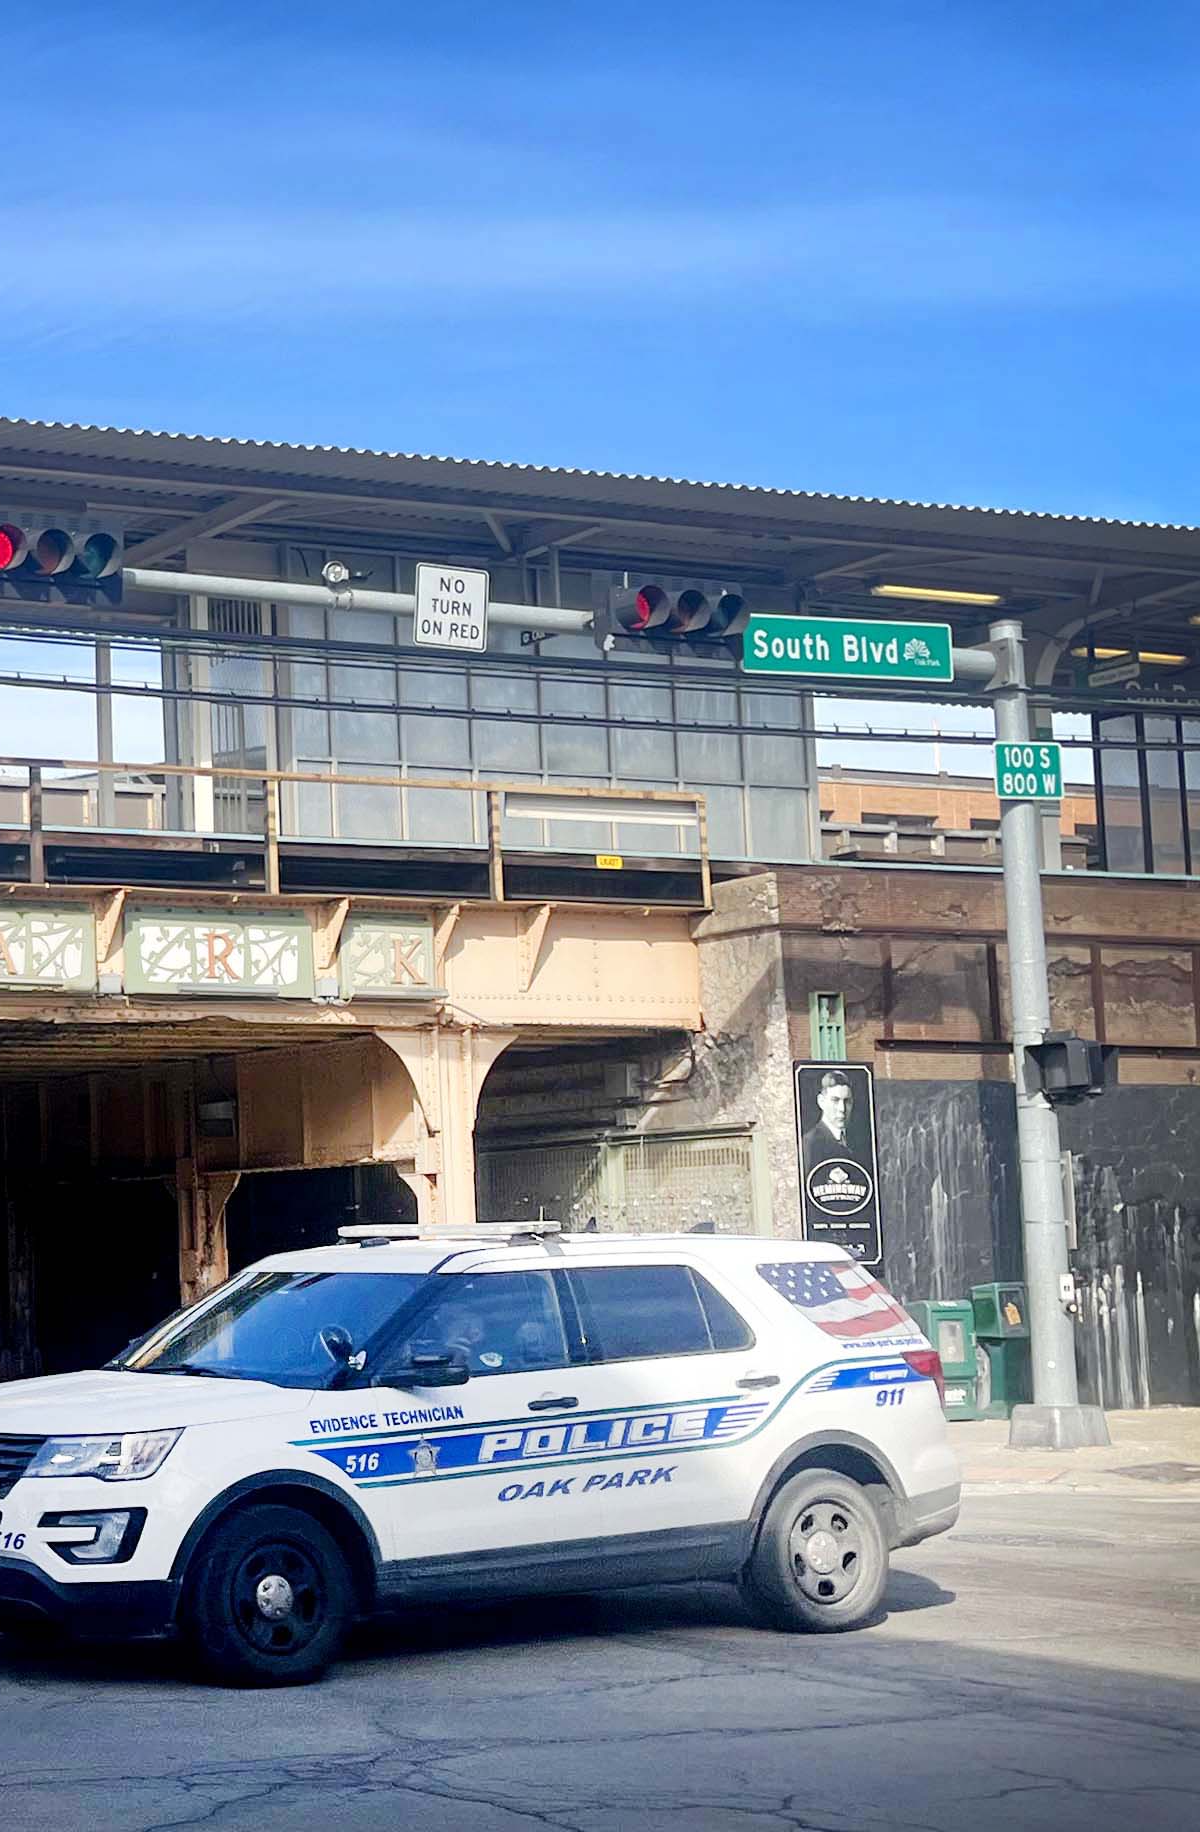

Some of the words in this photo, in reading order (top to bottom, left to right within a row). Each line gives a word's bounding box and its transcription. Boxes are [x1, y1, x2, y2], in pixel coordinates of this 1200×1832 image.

[440, 577, 465, 593] NO
[432, 598, 472, 617] TURN
[422, 619, 443, 636] ON
[450, 622, 480, 640] RED
[753, 629, 830, 661] South
[842, 633, 899, 665] Blvd
[1004, 747, 1035, 769] 100
[1040, 747, 1050, 769] S
[1003, 772, 1038, 794] 800
[1042, 773, 1056, 794] W
[812, 1183, 867, 1199] HEMINGWAY
[875, 1387, 905, 1407] 911
[309, 1413, 379, 1434] EVIDENCE
[382, 1405, 465, 1427] TECHNICIAN
[345, 1452, 381, 1473] 516
[477, 1409, 709, 1463] POLICE
[497, 1476, 578, 1502] OAK
[582, 1466, 679, 1493] PARK
